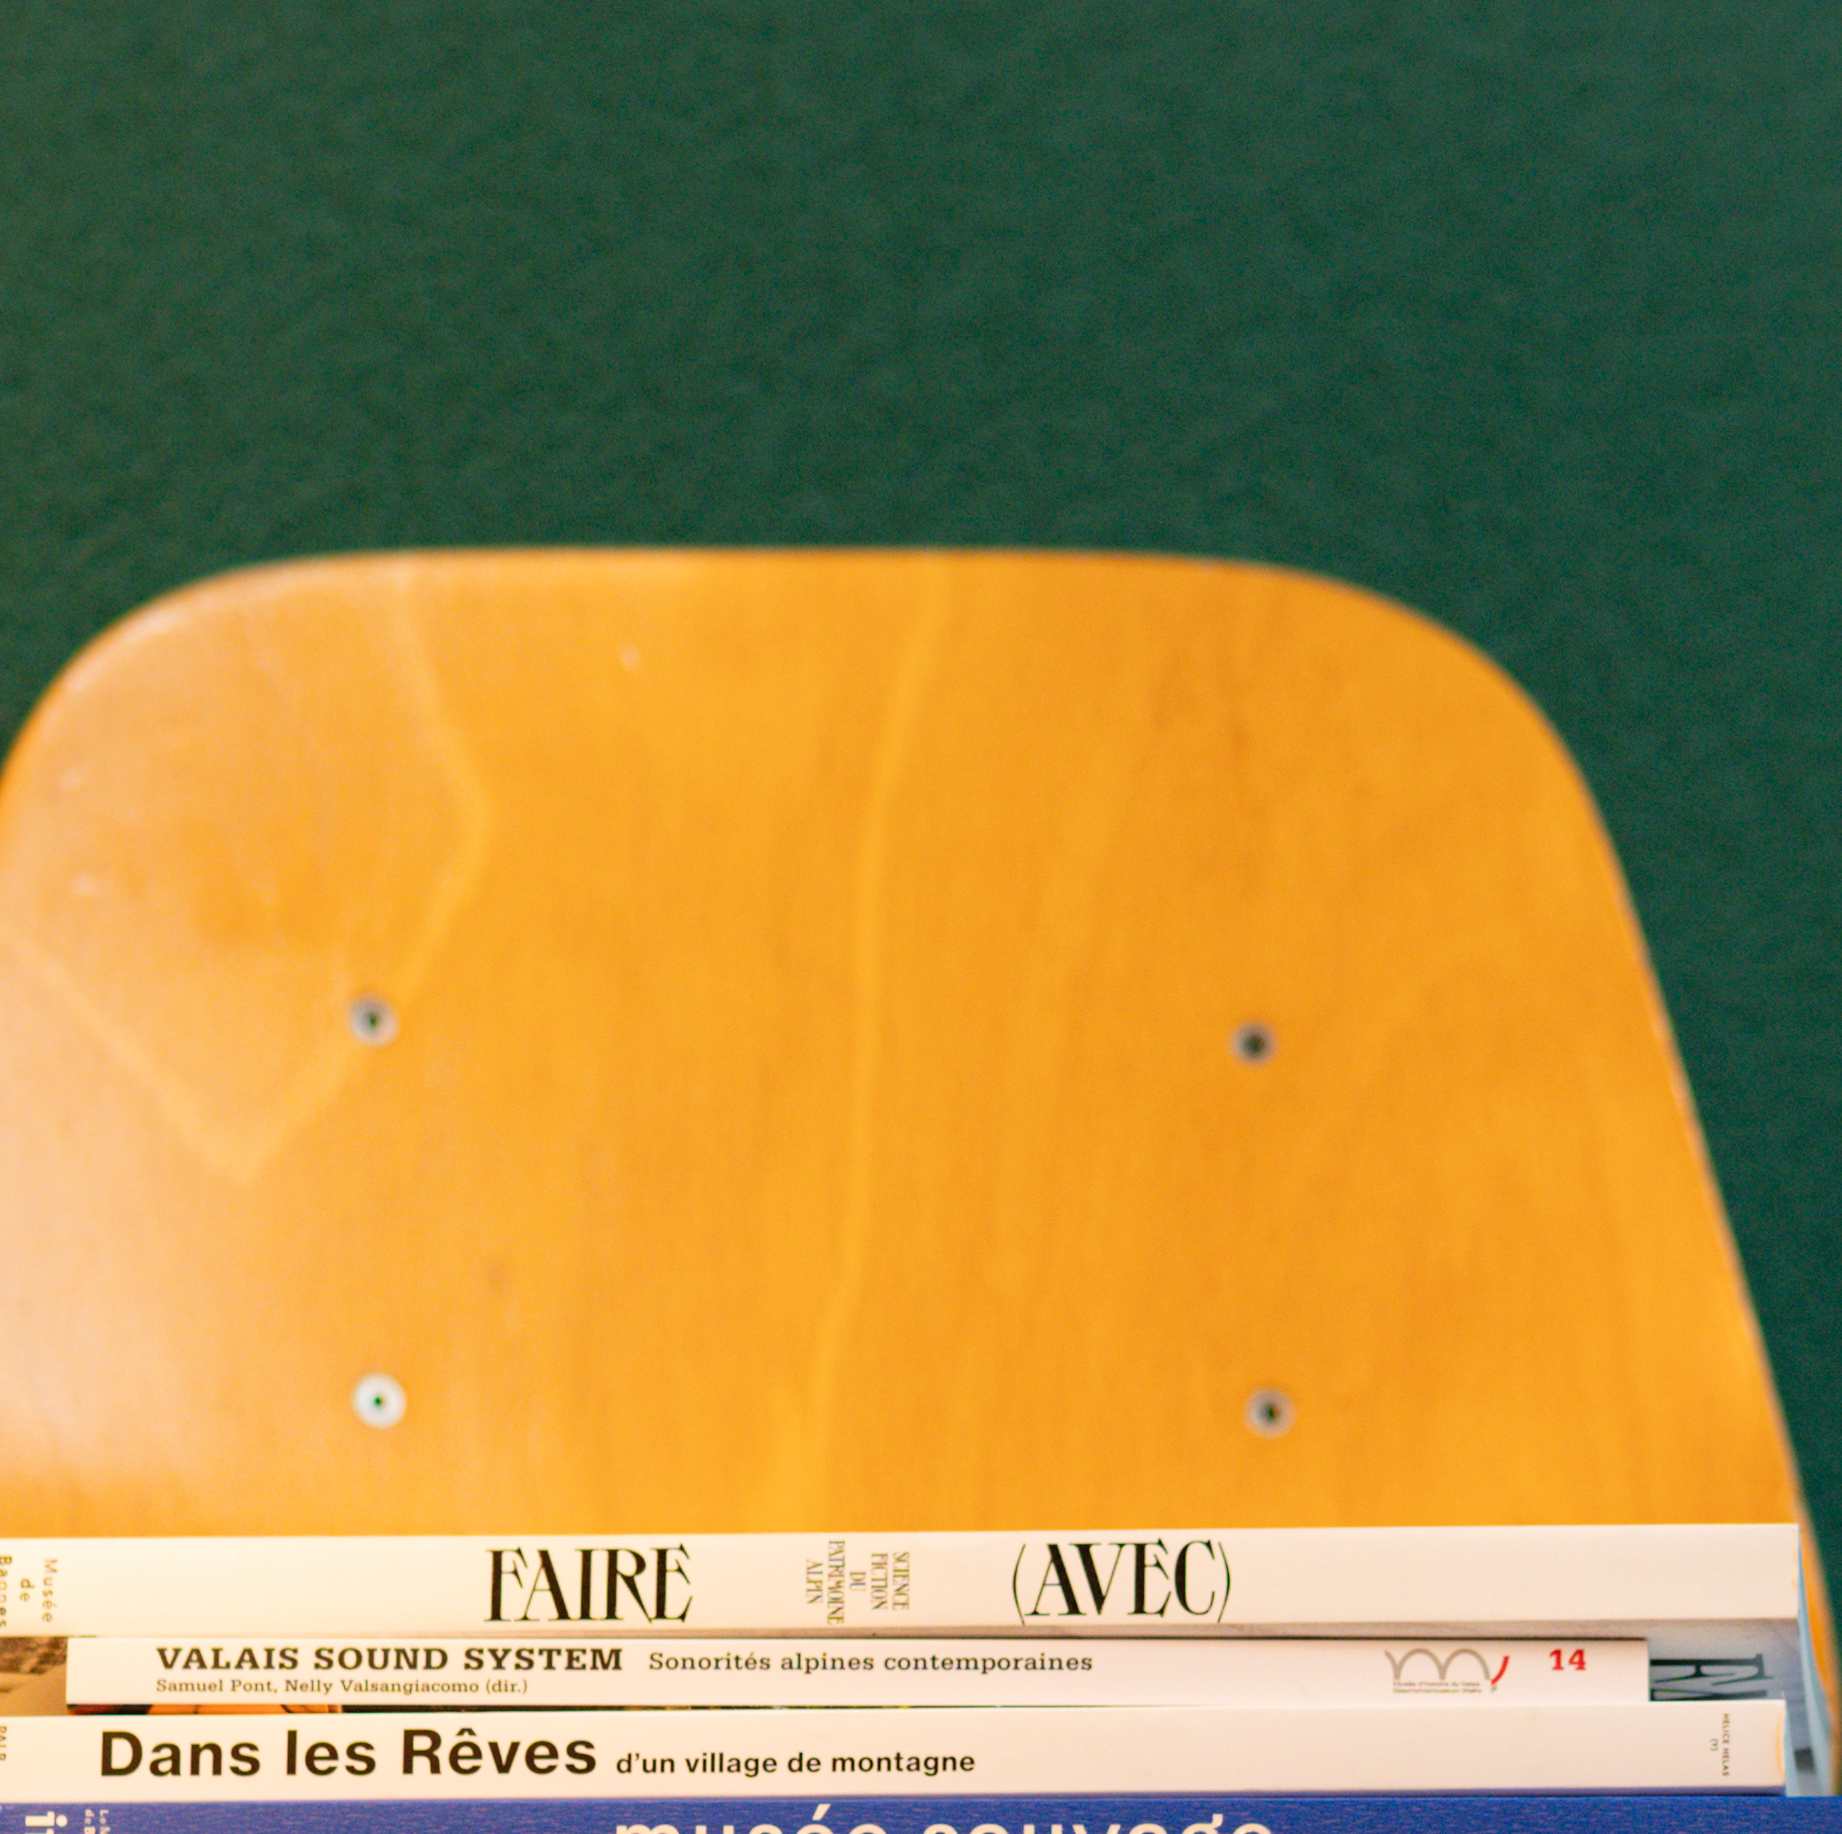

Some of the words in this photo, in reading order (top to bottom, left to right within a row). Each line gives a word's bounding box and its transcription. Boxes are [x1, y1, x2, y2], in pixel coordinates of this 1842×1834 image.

[20, 1578, 35, 1602] de
[42, 1558, 58, 1623] Musée
[483, 1542, 693, 1623] FAIRE
[805, 1559, 823, 1604] ALPIN
[827, 1540, 845, 1624] PATRIMOINE
[849, 1571, 866, 1591] DU
[871, 1553, 888, 1609] FICTION
[892, 1552, 909, 1610] SCIENCE
[1012, 1538, 1232, 1625] (AVEC)
[157, 1647, 299, 1671] VALAIS
[313, 1646, 448, 1671] SOUND
[464, 1647, 623, 1671] SYSTEM
[648, 1650, 771, 1671] Sonorités
[780, 1651, 874, 1676] alpines
[884, 1652, 1093, 1676] contemporaines
[1549, 1649, 1586, 1671] 14
[157, 1678, 222, 1693] Samuel
[230, 1678, 278, 1696] Pont,
[285, 1678, 333, 1698] Nelly
[340, 1678, 480, 1698] Valsangiacomo
[486, 1678, 528, 1697] (dir.)
[101, 1730, 260, 1777] Dans
[286, 1730, 377, 1777] les
[402, 1729, 597, 1777] Rêves
[616, 1751, 676, 1775] d'un
[684, 1750, 778, 1778] village
[787, 1750, 821, 1774] de
[831, 1751, 975, 1778] montagne
